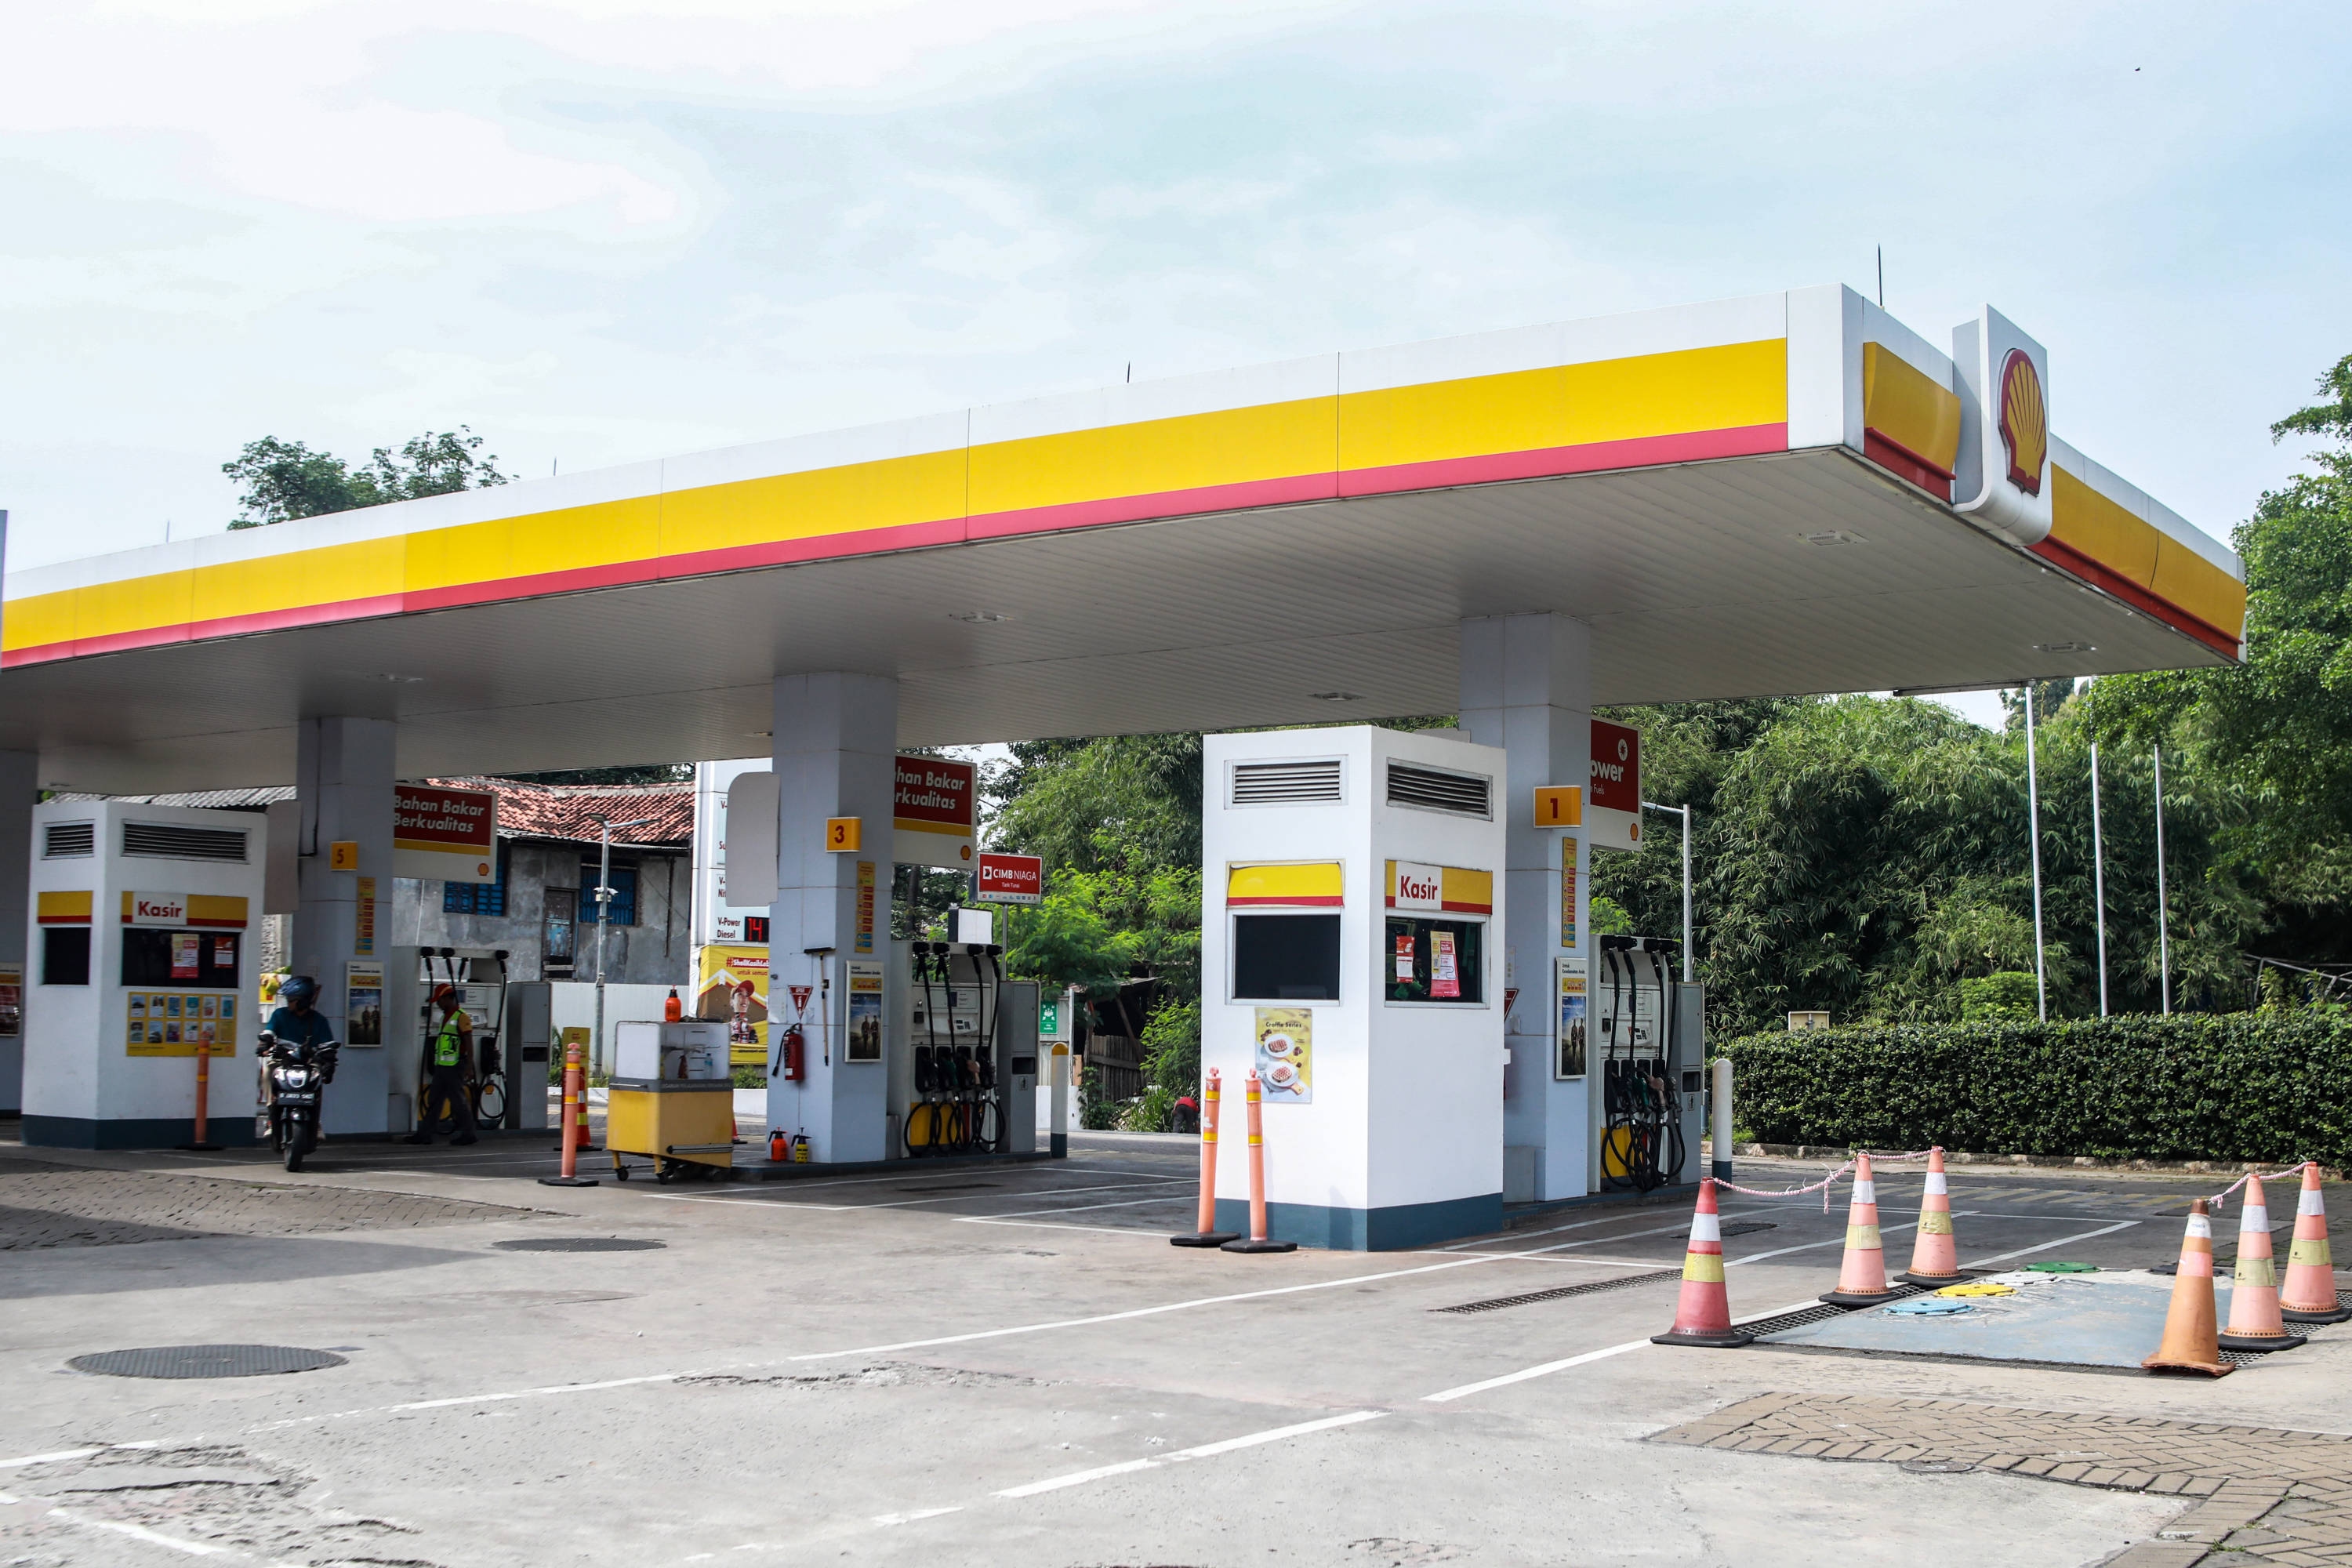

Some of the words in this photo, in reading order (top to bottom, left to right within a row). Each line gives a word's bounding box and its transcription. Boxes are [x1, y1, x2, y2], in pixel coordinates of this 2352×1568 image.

[895, 766, 922, 785] han
[926, 771, 965, 791] Bakar
[1590, 759, 1624, 782] ower
[895, 787, 956, 810] rkualitas
[1593, 784, 1605, 795] Fuels
[394, 795, 438, 812] Bahan
[442, 800, 485, 816] Bakar
[1550, 797, 1559, 818] 1
[394, 812, 474, 833] Berkualitas
[834, 825, 844, 844] 3
[336, 848, 344, 864] 5
[1400, 875, 1438, 900] Kasir
[138, 901, 182, 917] Kasir
[717, 916, 741, 927] V-Power
[747, 917, 770, 941] 14
[717, 929, 736, 938] Diesel
